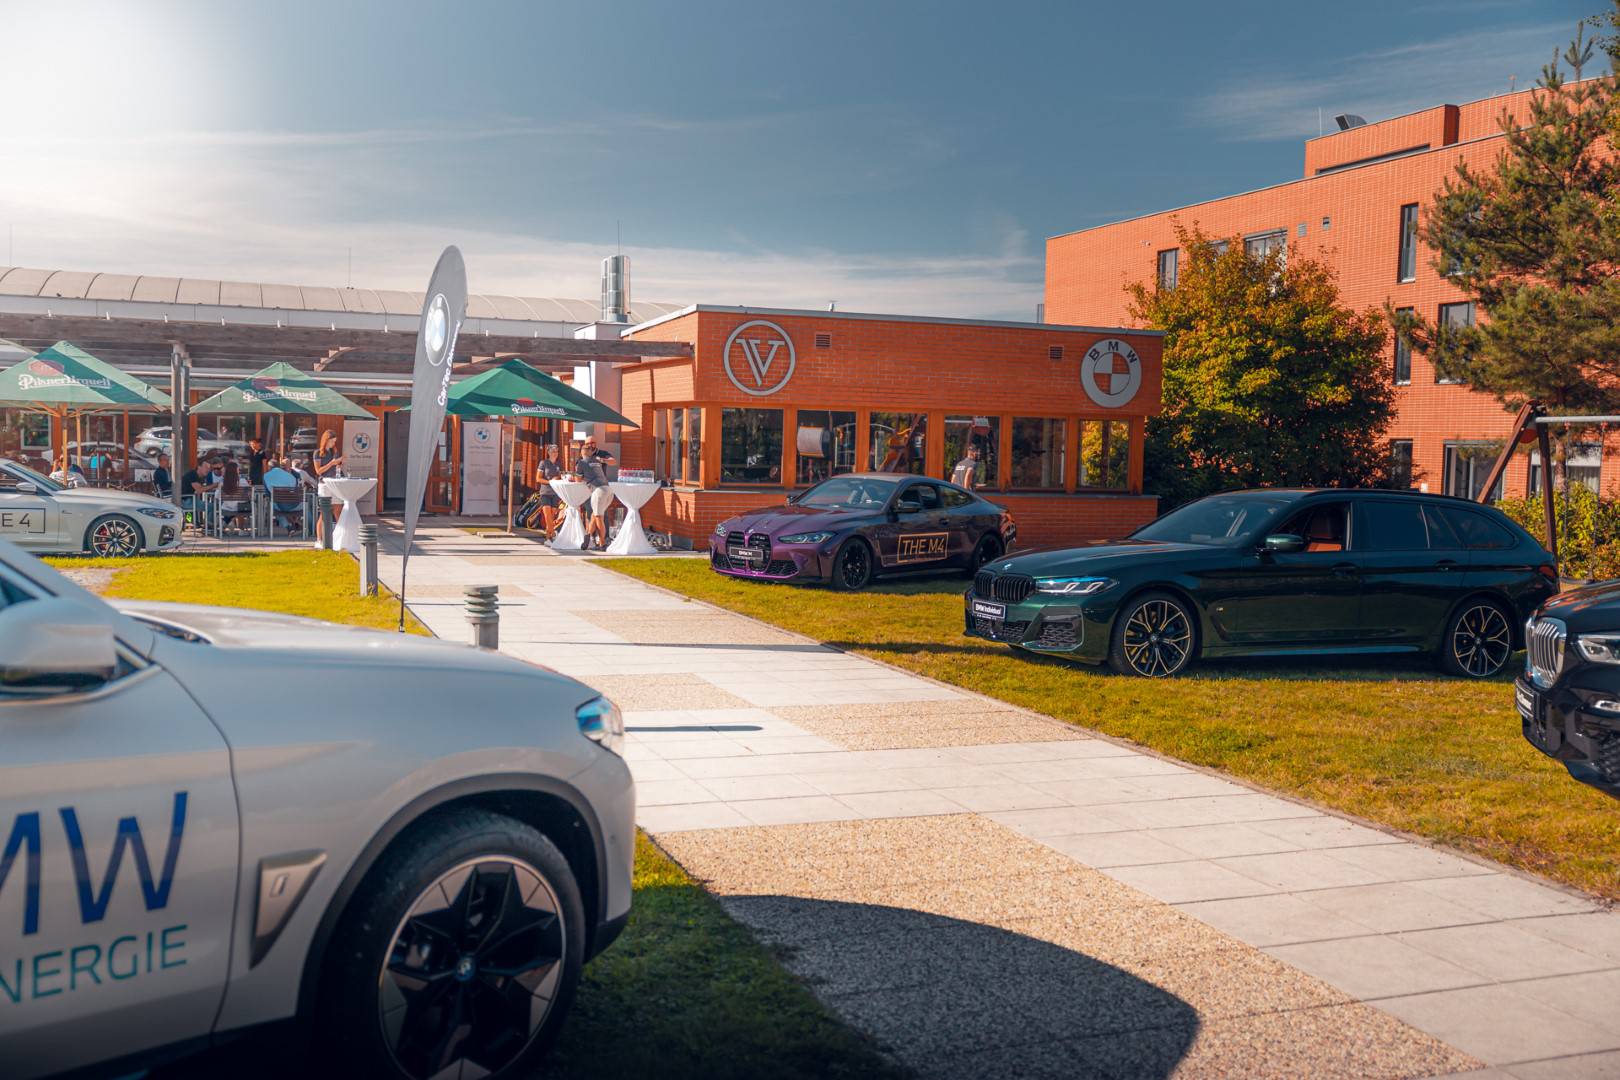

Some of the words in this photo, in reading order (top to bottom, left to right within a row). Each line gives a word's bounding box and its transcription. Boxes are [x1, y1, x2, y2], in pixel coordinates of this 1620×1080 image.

[1088, 340, 1138, 364] BMW
[902, 539, 927, 556] THE
[928, 537, 945, 554] M4
[0, 924, 188, 1004] NERGIE
